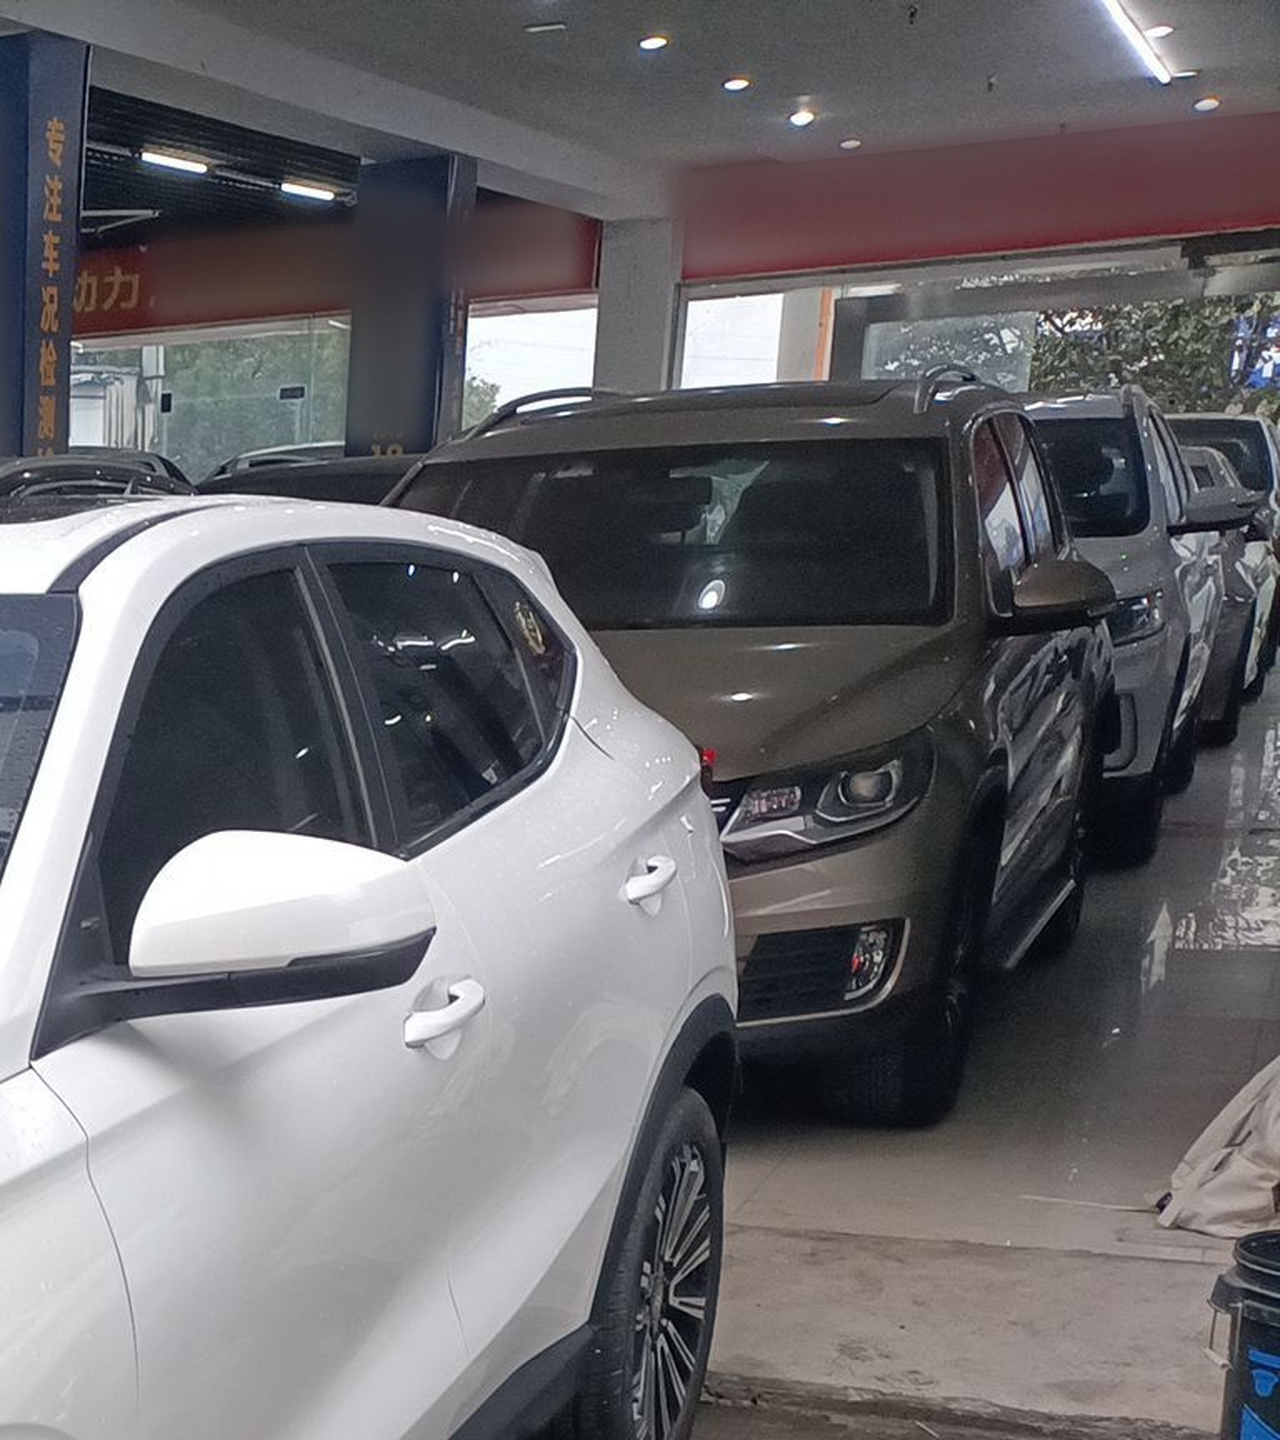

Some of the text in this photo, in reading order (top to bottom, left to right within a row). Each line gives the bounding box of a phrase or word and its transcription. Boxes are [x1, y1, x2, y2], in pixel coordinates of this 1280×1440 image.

[38, 116, 67, 457] 专注车况检测
